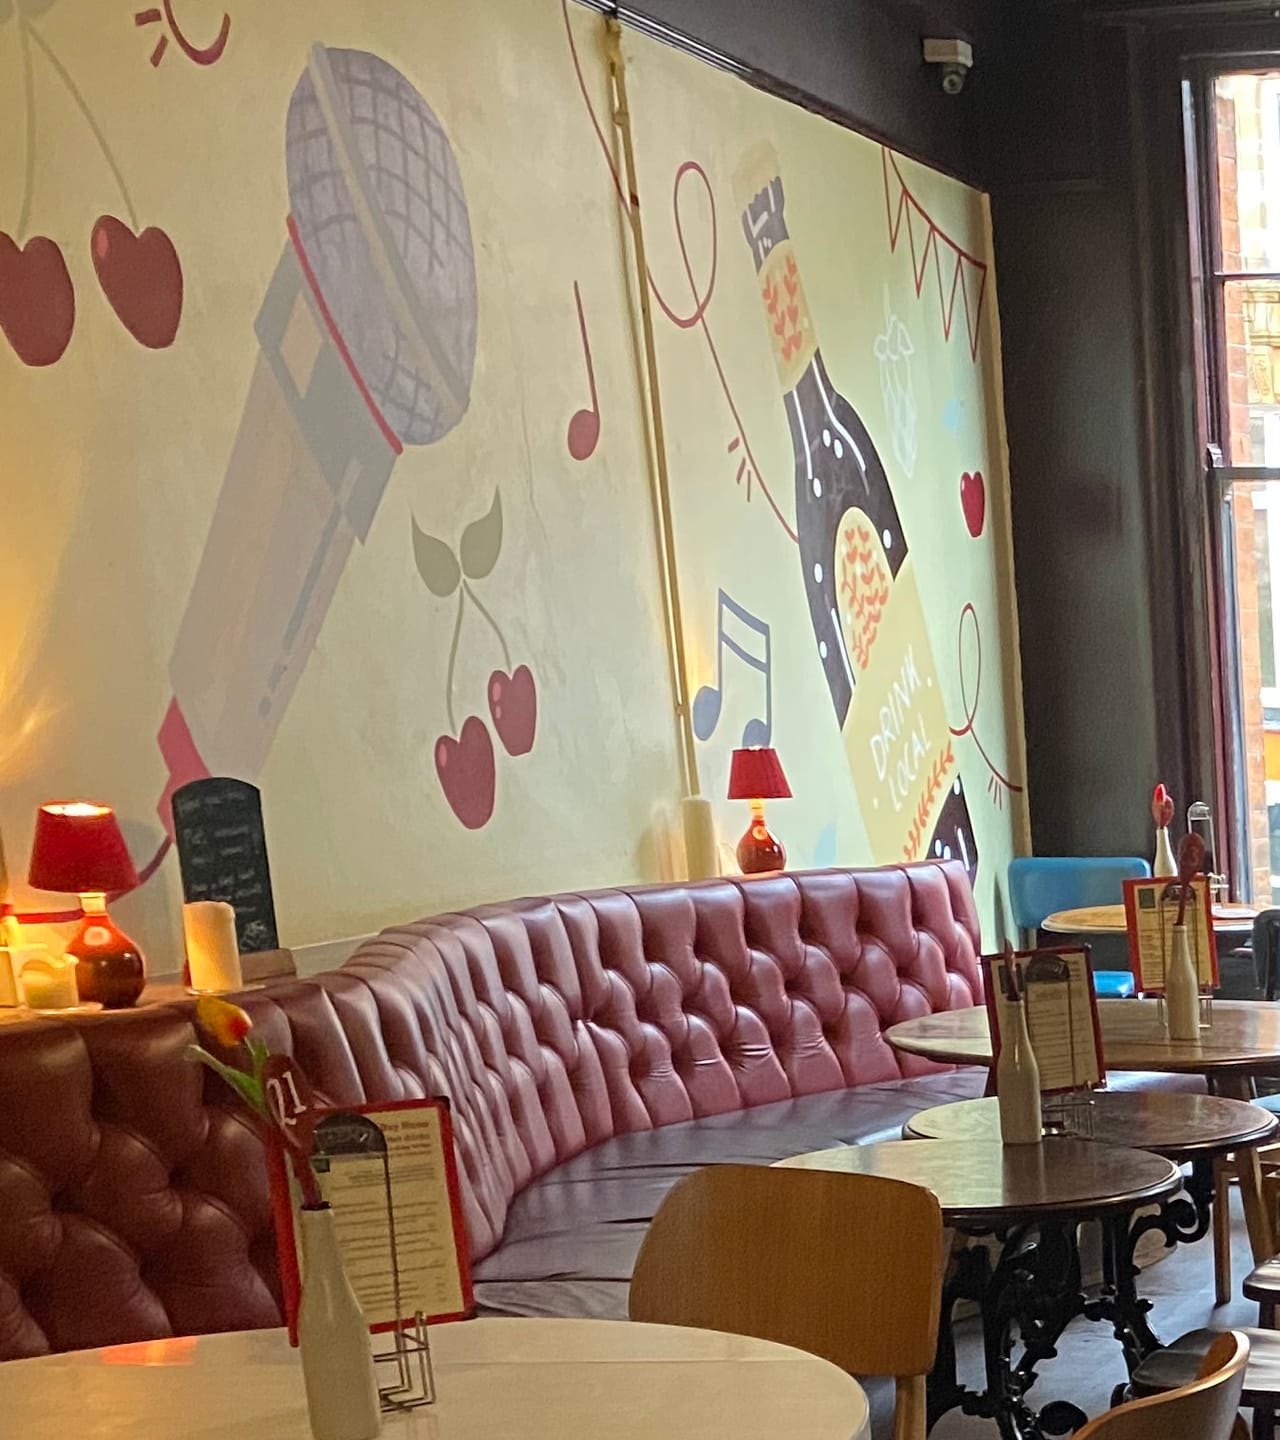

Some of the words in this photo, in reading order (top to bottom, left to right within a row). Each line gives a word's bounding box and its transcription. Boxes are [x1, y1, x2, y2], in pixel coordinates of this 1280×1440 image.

[870, 643, 922, 783] DRINK
[888, 711, 932, 813] LOCAL
[266, 1070, 307, 1127] 21
